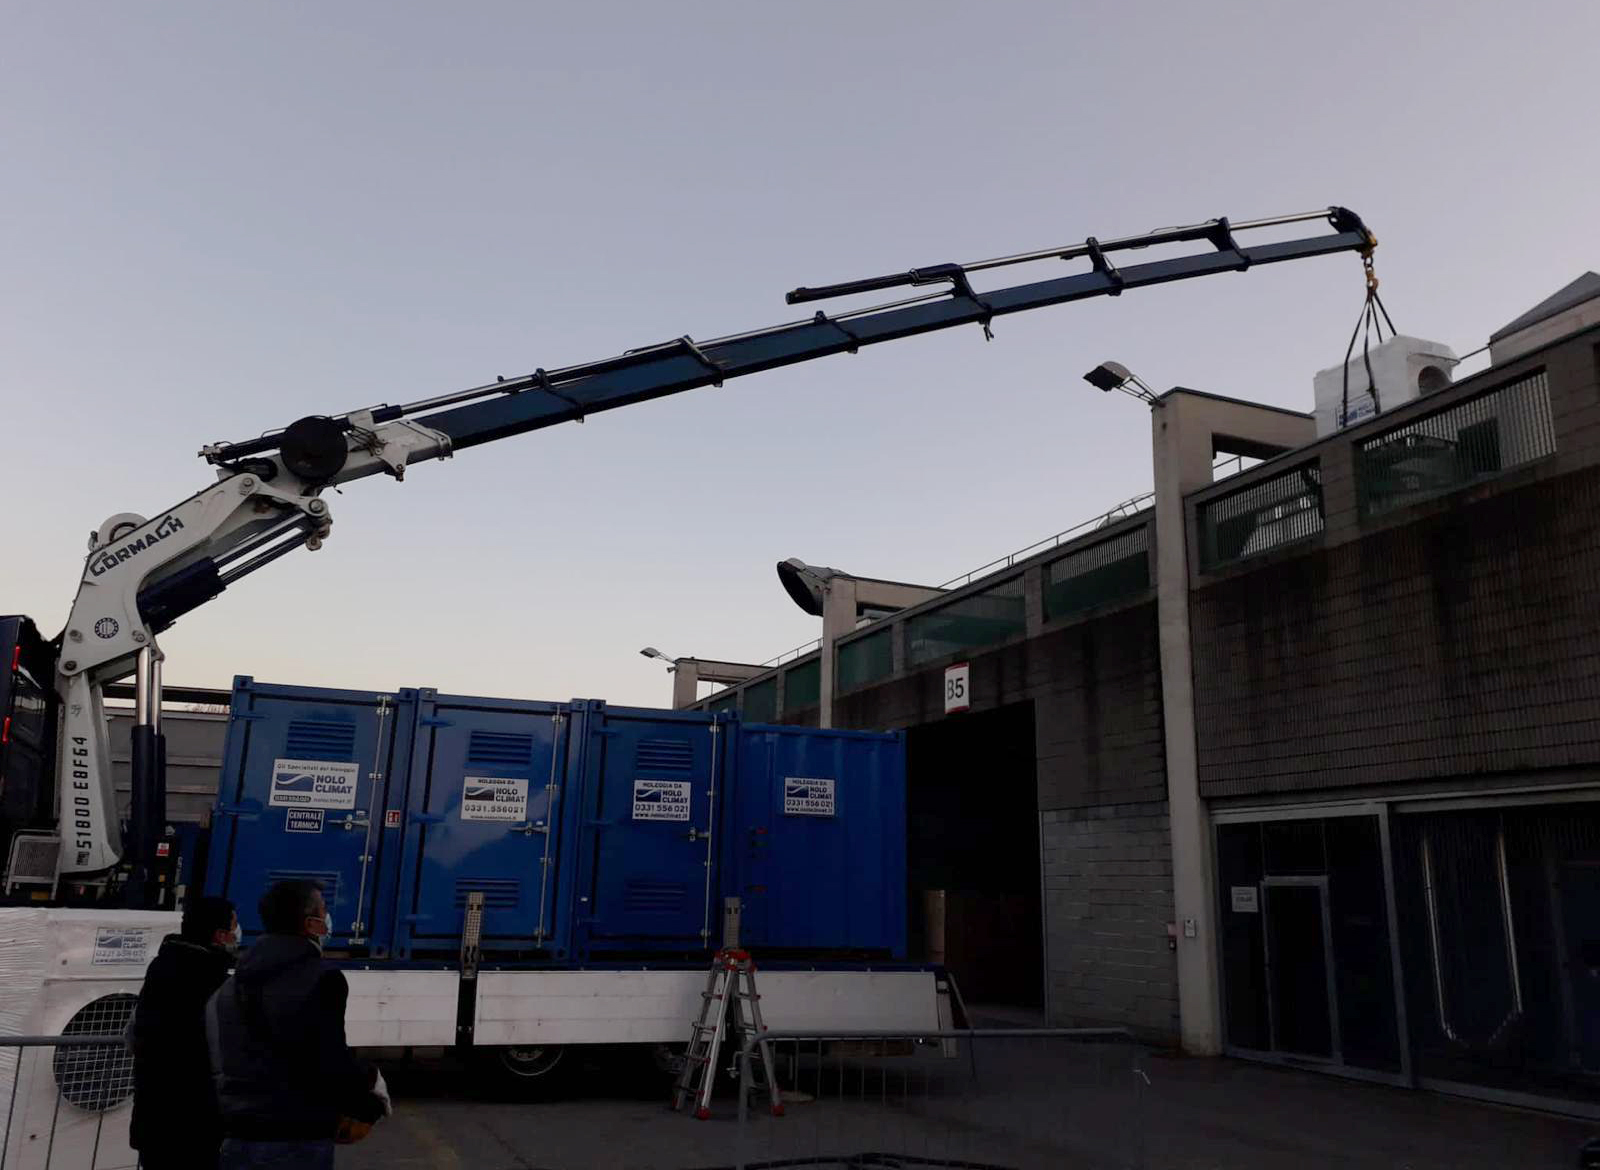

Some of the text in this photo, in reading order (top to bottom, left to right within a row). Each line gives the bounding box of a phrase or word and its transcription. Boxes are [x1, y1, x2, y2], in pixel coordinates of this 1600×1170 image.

[89, 515, 184, 577] CORMACH
[947, 677, 964, 700] B5
[316, 775, 346, 784] NOLO
[315, 784, 353, 794] CLIMAT
[495, 787, 518, 795] NOLO
[289, 811, 322, 820] CENTRALE
[74, 796, 92, 850] 51800
[290, 820, 319, 829] TERMICA
